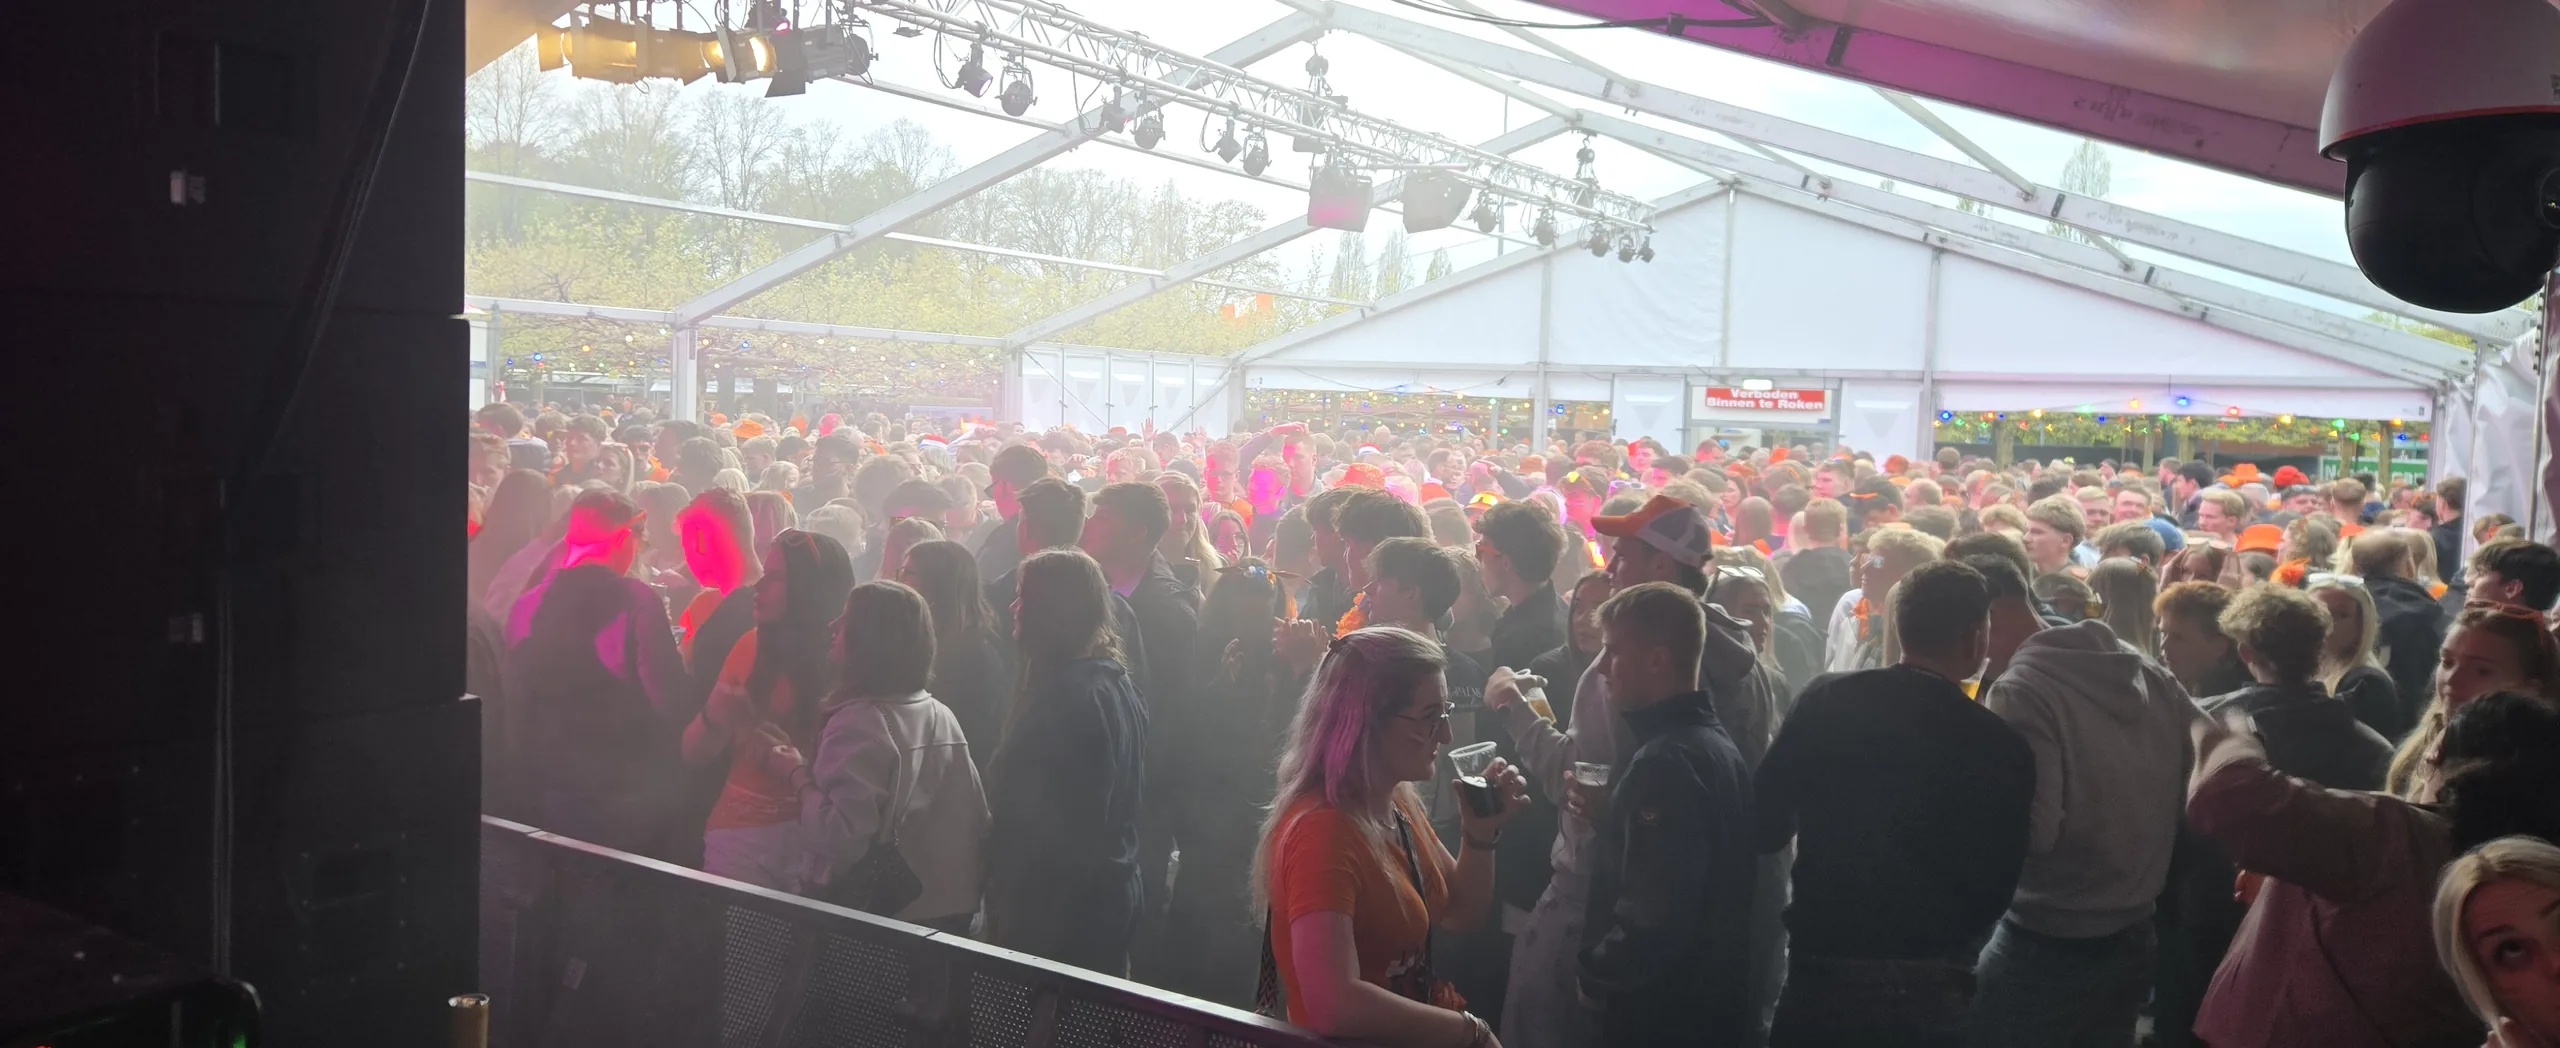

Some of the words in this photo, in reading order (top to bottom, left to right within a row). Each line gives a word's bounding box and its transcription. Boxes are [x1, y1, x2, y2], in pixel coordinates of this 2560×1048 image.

[1731, 389, 1799, 399] Verboden
[1707, 397, 1755, 408] Binnen
[1759, 399, 1773, 409] te
[1778, 400, 1823, 410] Roken
